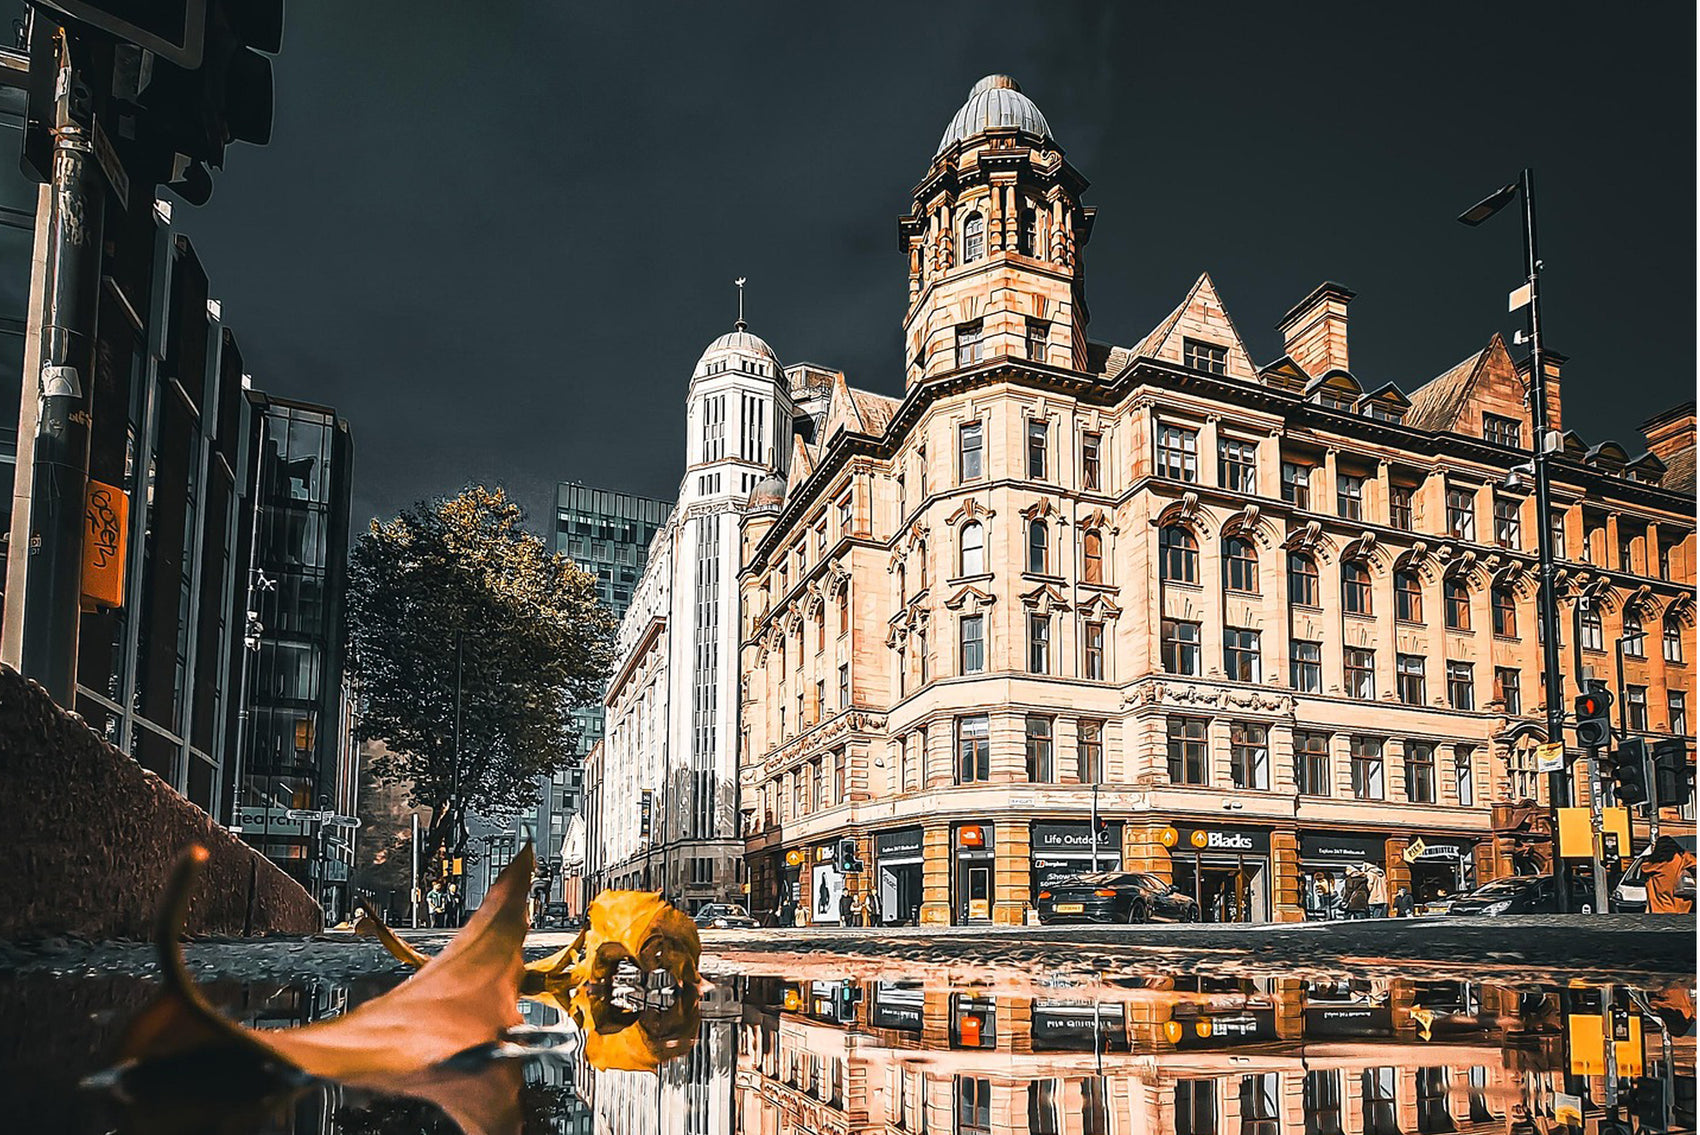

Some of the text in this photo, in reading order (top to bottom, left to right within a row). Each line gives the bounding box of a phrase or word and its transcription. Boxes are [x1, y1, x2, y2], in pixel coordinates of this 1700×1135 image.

[240, 814, 301, 826] earch.
[1044, 834, 1109, 845] Life Outdo
[1208, 832, 1253, 848] Blacks
